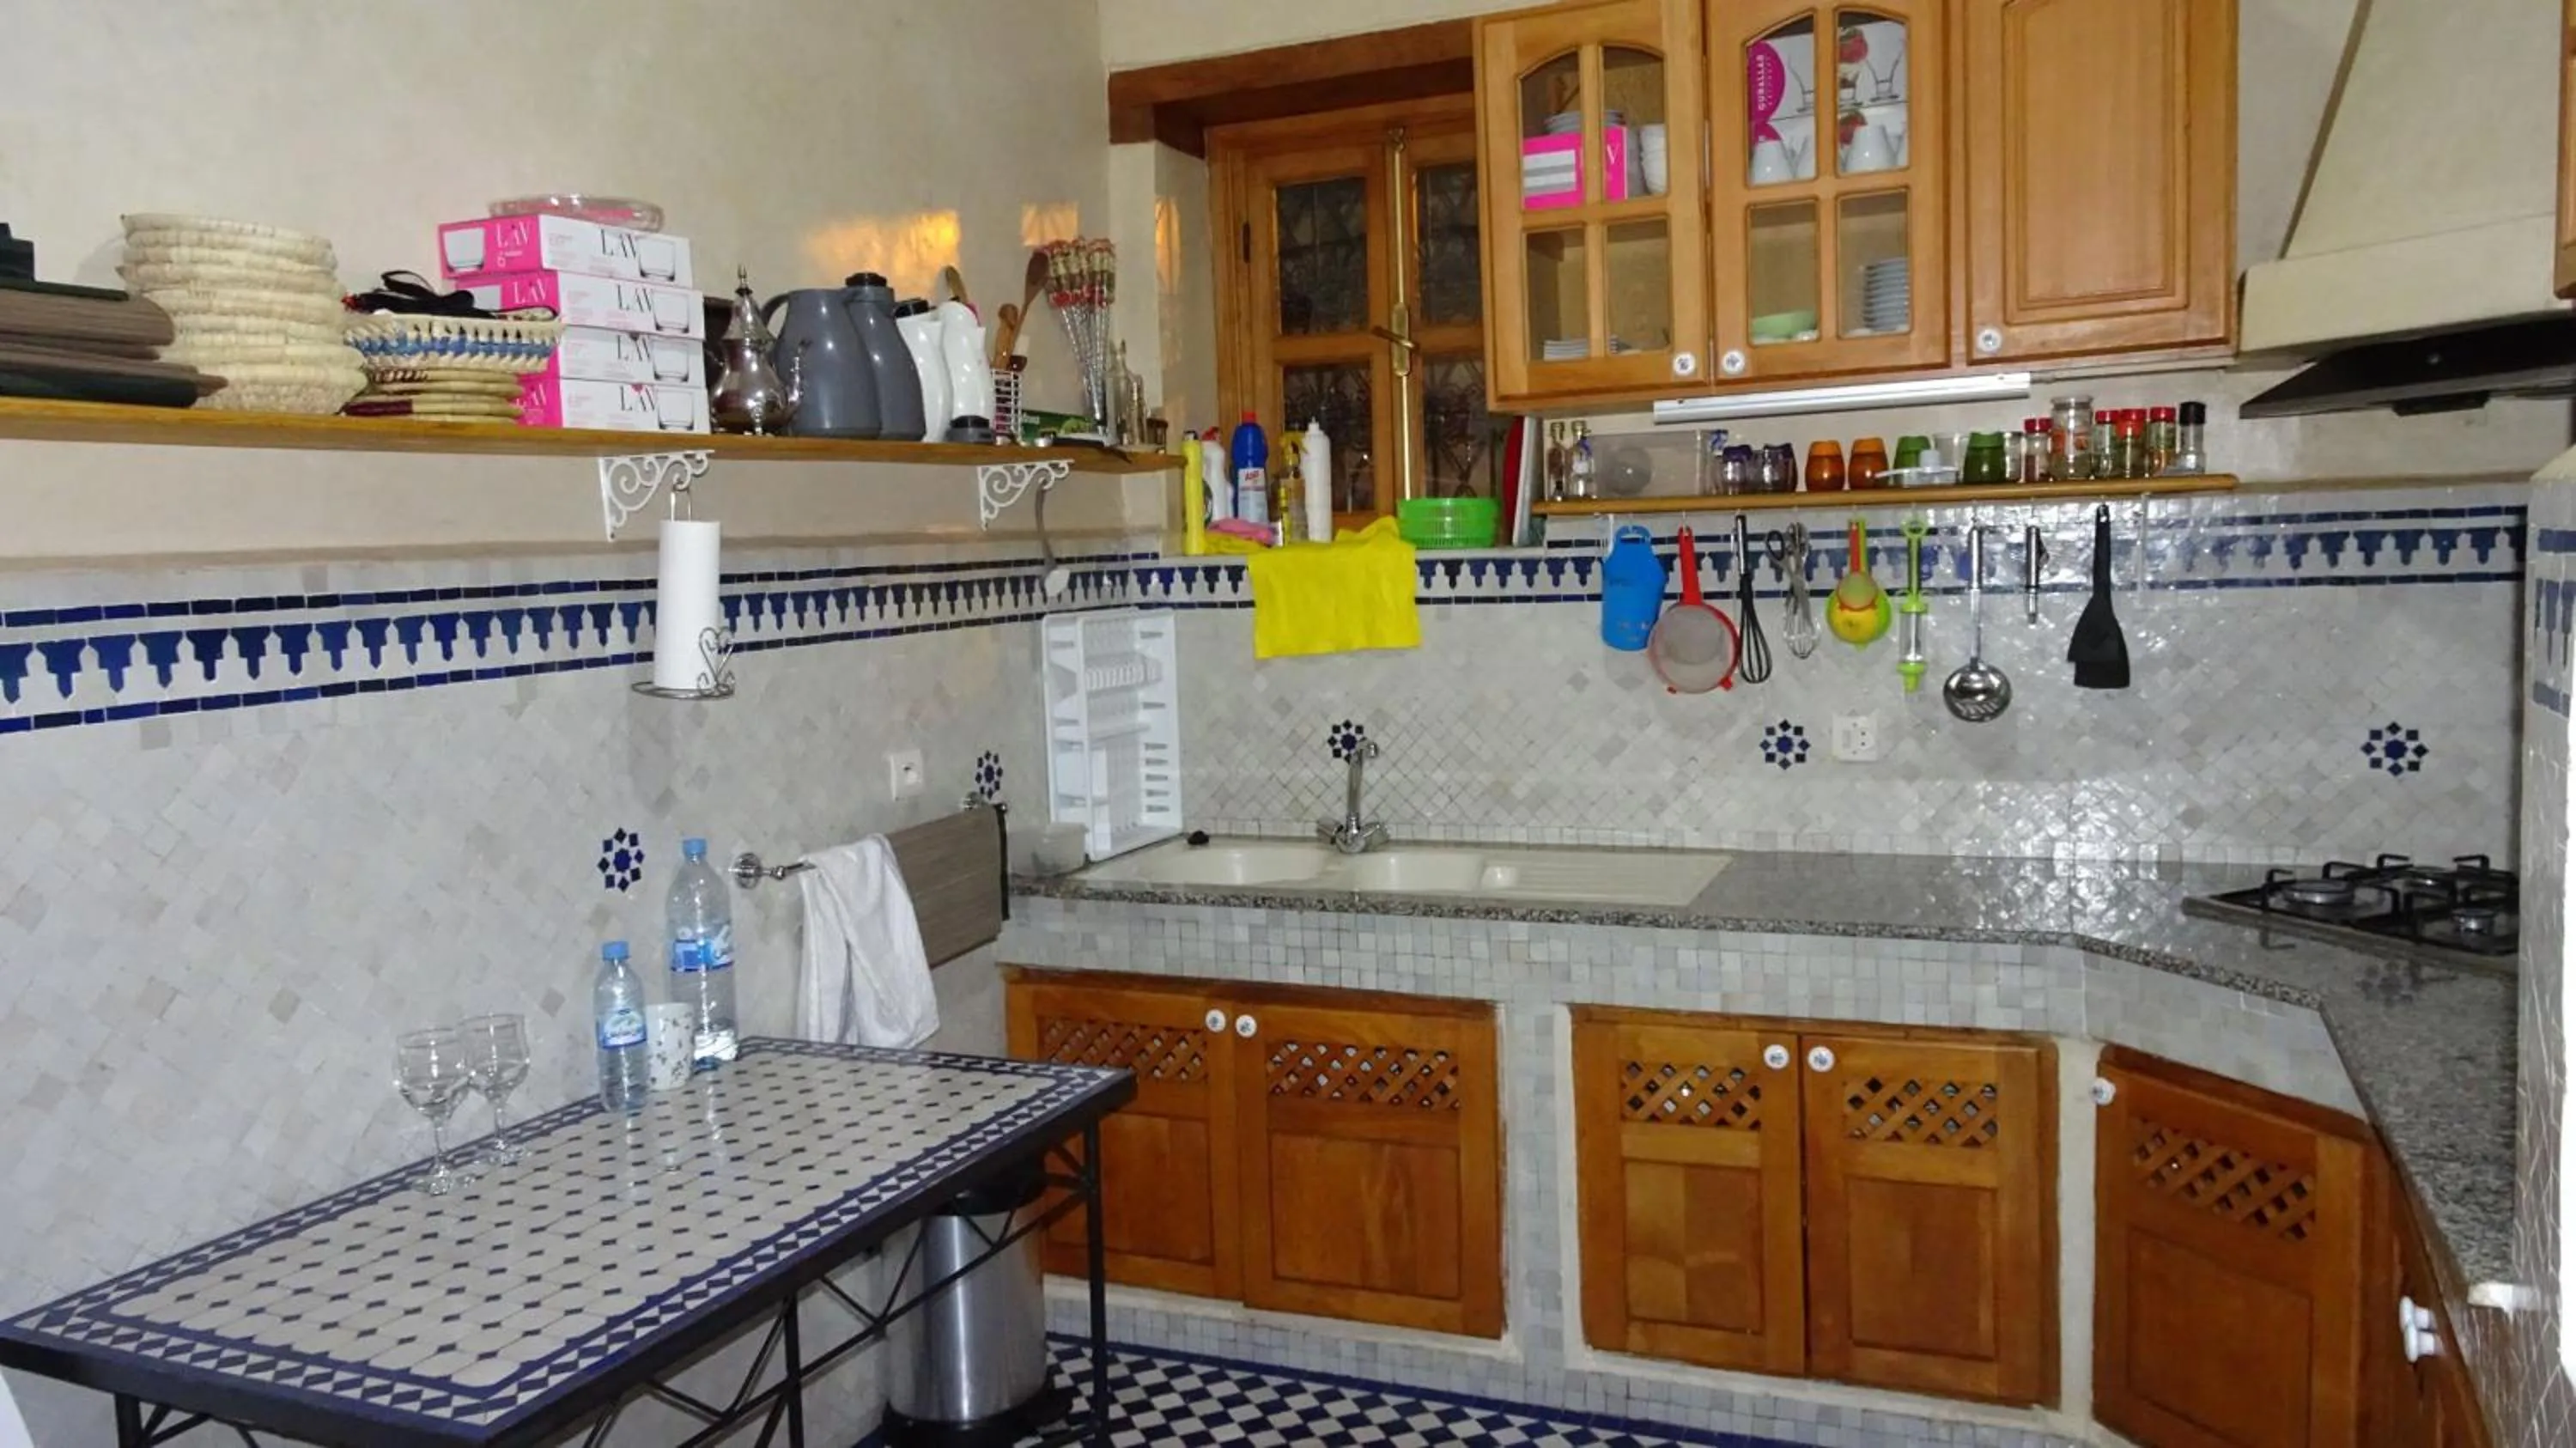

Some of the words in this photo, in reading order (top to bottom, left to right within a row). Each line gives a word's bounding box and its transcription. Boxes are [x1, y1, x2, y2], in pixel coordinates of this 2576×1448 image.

[495, 220, 531, 248] LAV
[600, 228, 639, 259] LAV
[513, 277, 548, 305] LAV
[617, 284, 654, 313] LAV
[617, 334, 653, 362] LAV
[620, 386, 657, 412] LAV
